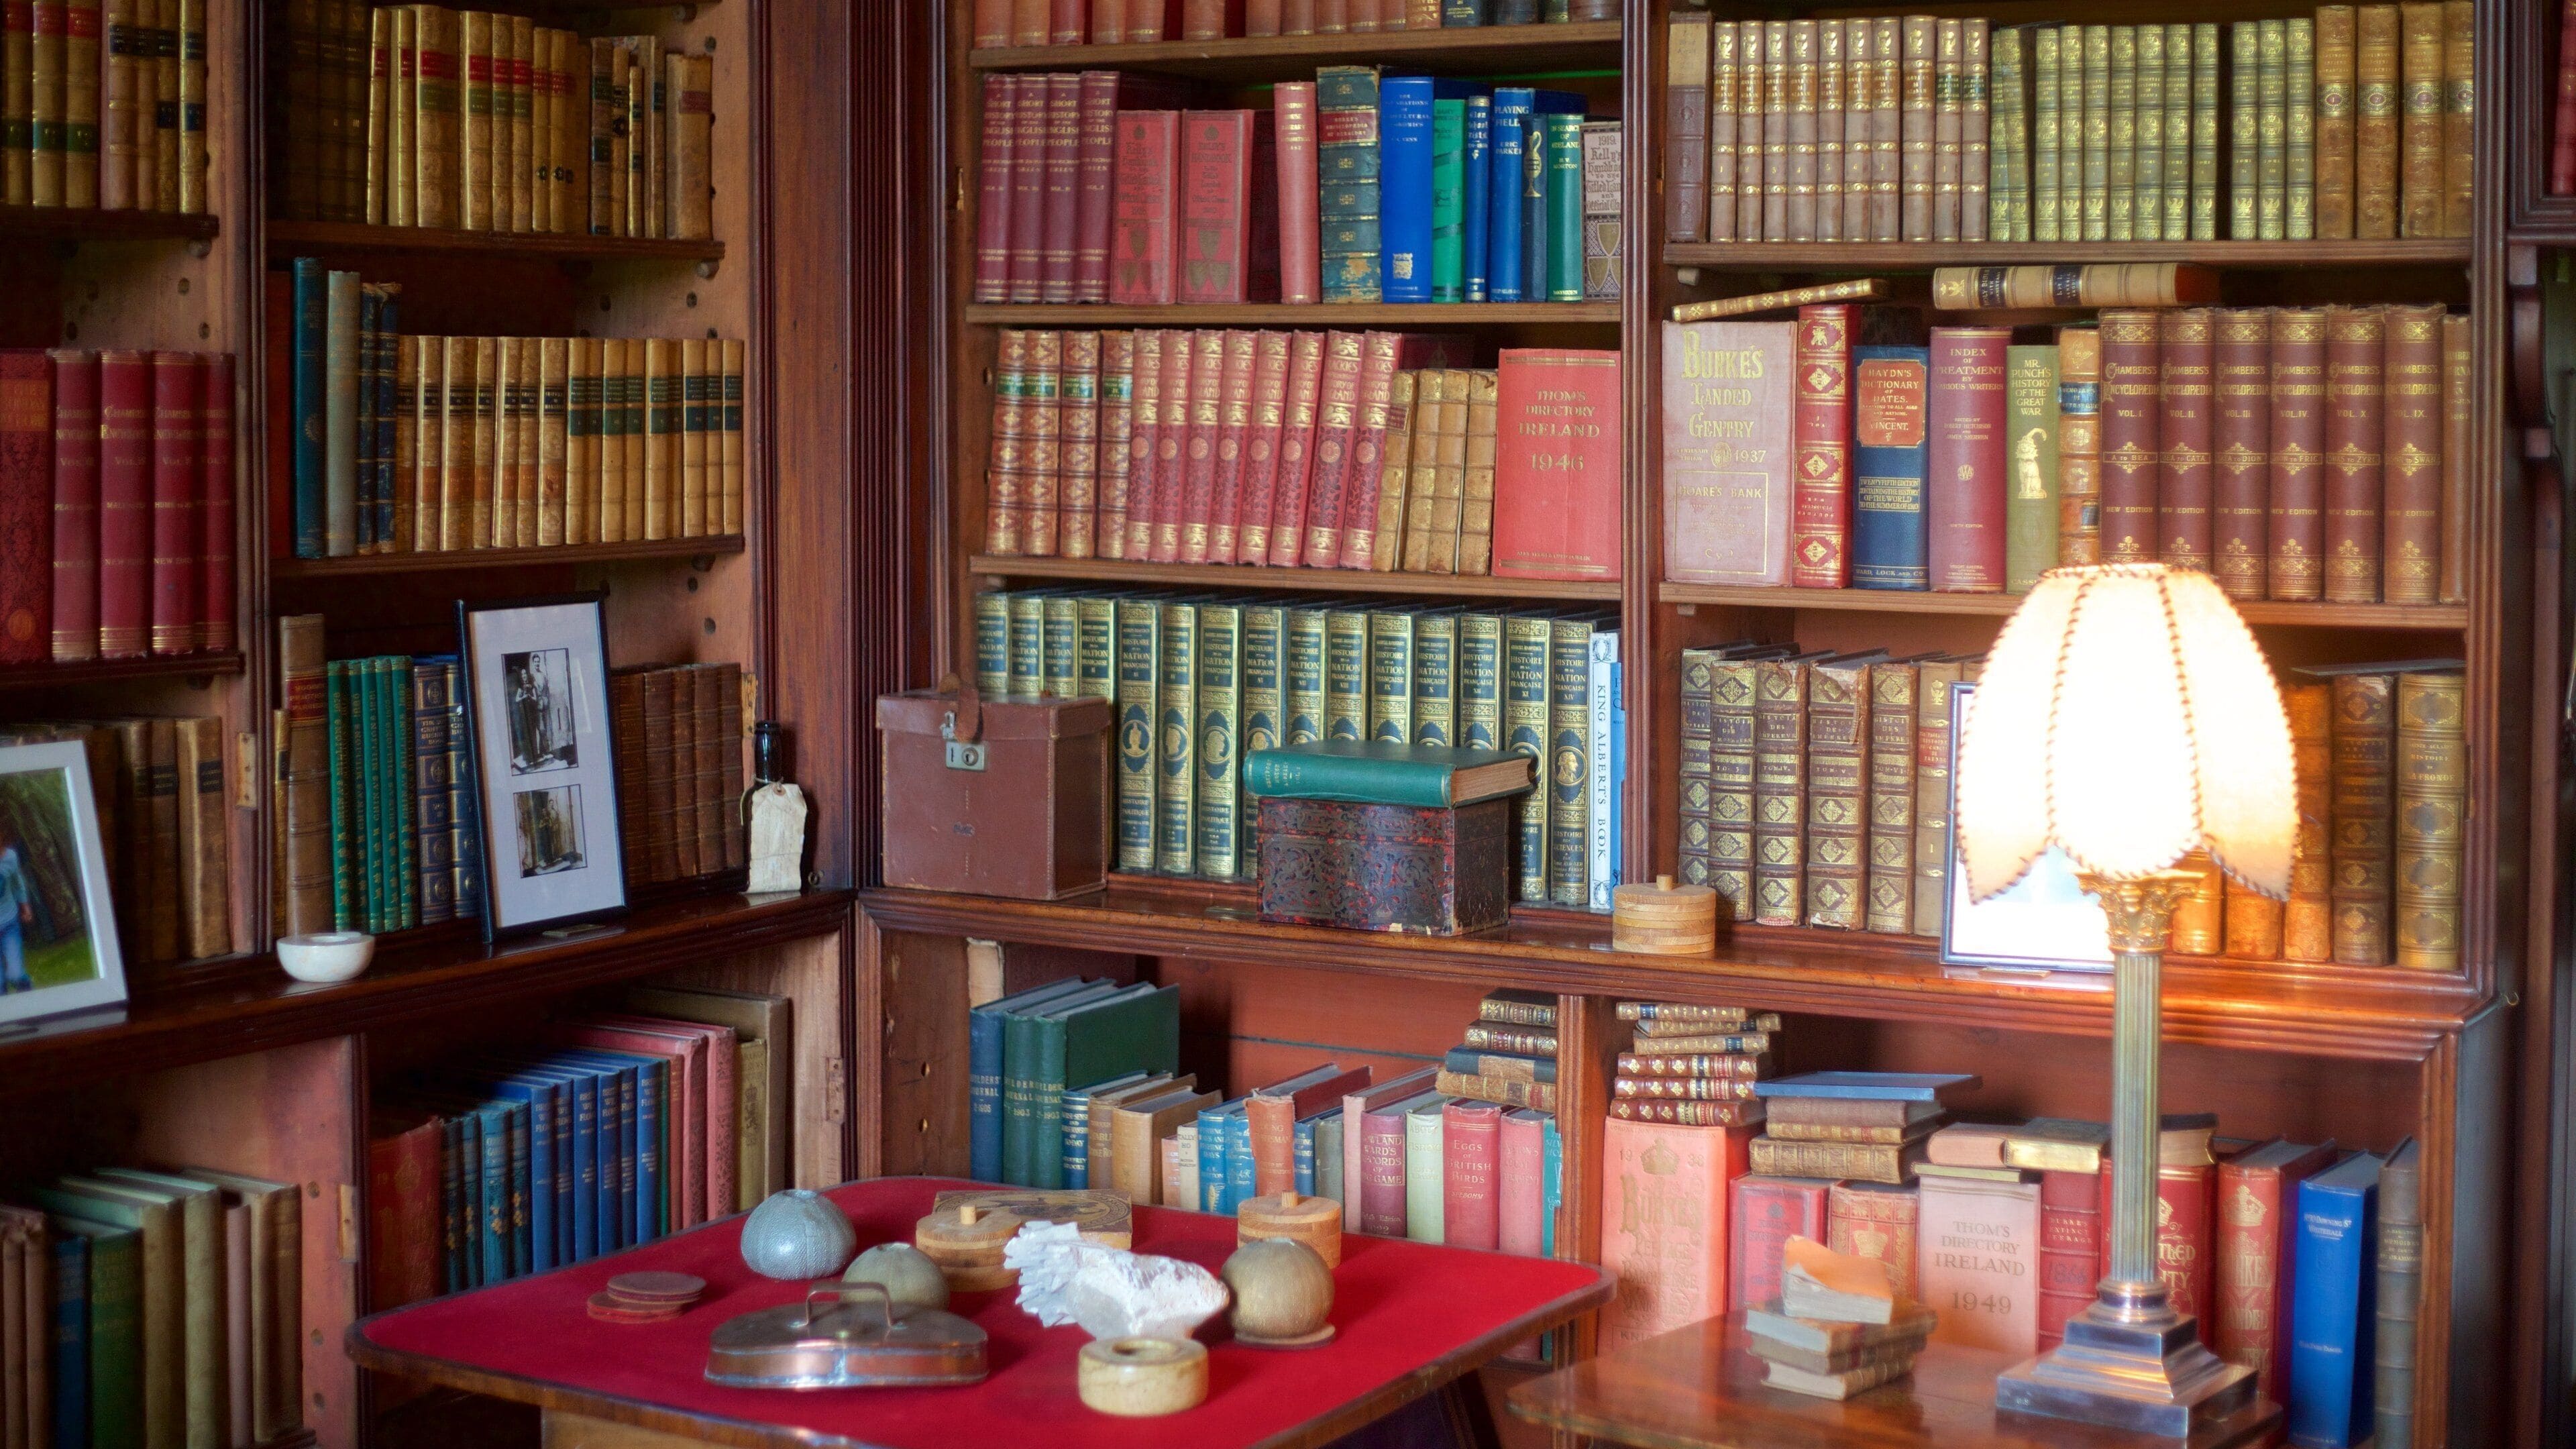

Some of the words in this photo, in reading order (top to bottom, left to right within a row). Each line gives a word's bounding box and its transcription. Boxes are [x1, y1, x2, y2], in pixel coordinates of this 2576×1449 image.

[1496, 118, 1519, 127] FIELD
[1681, 330, 1764, 379] BURKE'S
[1951, 348, 1986, 356] INDEX
[1869, 369, 1912, 377] HAYDN'S
[1935, 366, 2004, 374] TREATMENT
[2012, 367, 2051, 377] PUNCH'S
[1862, 380, 1919, 389] DICTIONARY
[2012, 379, 2051, 388] HISTORY
[1691, 382, 1752, 410] LANDED
[2017, 398, 2045, 406] GREAT
[1525, 405, 1595, 417] DIRECTORY
[1519, 423, 1600, 437] IRELAND
[1688, 412, 1754, 438] GENTRY
[1530, 453, 1585, 471] 1946
[1735, 450, 1766, 463] 1937
[1731, 488, 1762, 498] BANK
[1376, 651, 1404, 659] HISTOIRE
[1511, 656, 1542, 664] HISTOIRE
[1291, 661, 1319, 669] NATION
[1376, 666, 1405, 674] NATION
[1418, 667, 1448, 676] NATION
[1464, 668, 1493, 676] NATION
[1511, 671, 1542, 680] NATION
[1598, 685, 1606, 722] KING
[370, 716, 378, 770] MILLIONS
[1598, 731, 1606, 805] ALBERT'S
[1598, 818, 1606, 861] BOOK
[1454, 1140, 1483, 1151] EGGS
[1448, 1160, 1491, 1171] BRITISH
[1374, 1175, 1402, 1183] GAME
[1452, 1172, 1485, 1183] BIRDS
[1953, 1221, 2010, 1238] THOM'S
[2308, 1225, 2343, 1236] WHITEHALL
[1941, 1235, 2019, 1254] DIRECTORY
[1934, 1252, 2025, 1277] IRELAND
[1953, 1292, 2011, 1315] 1949
